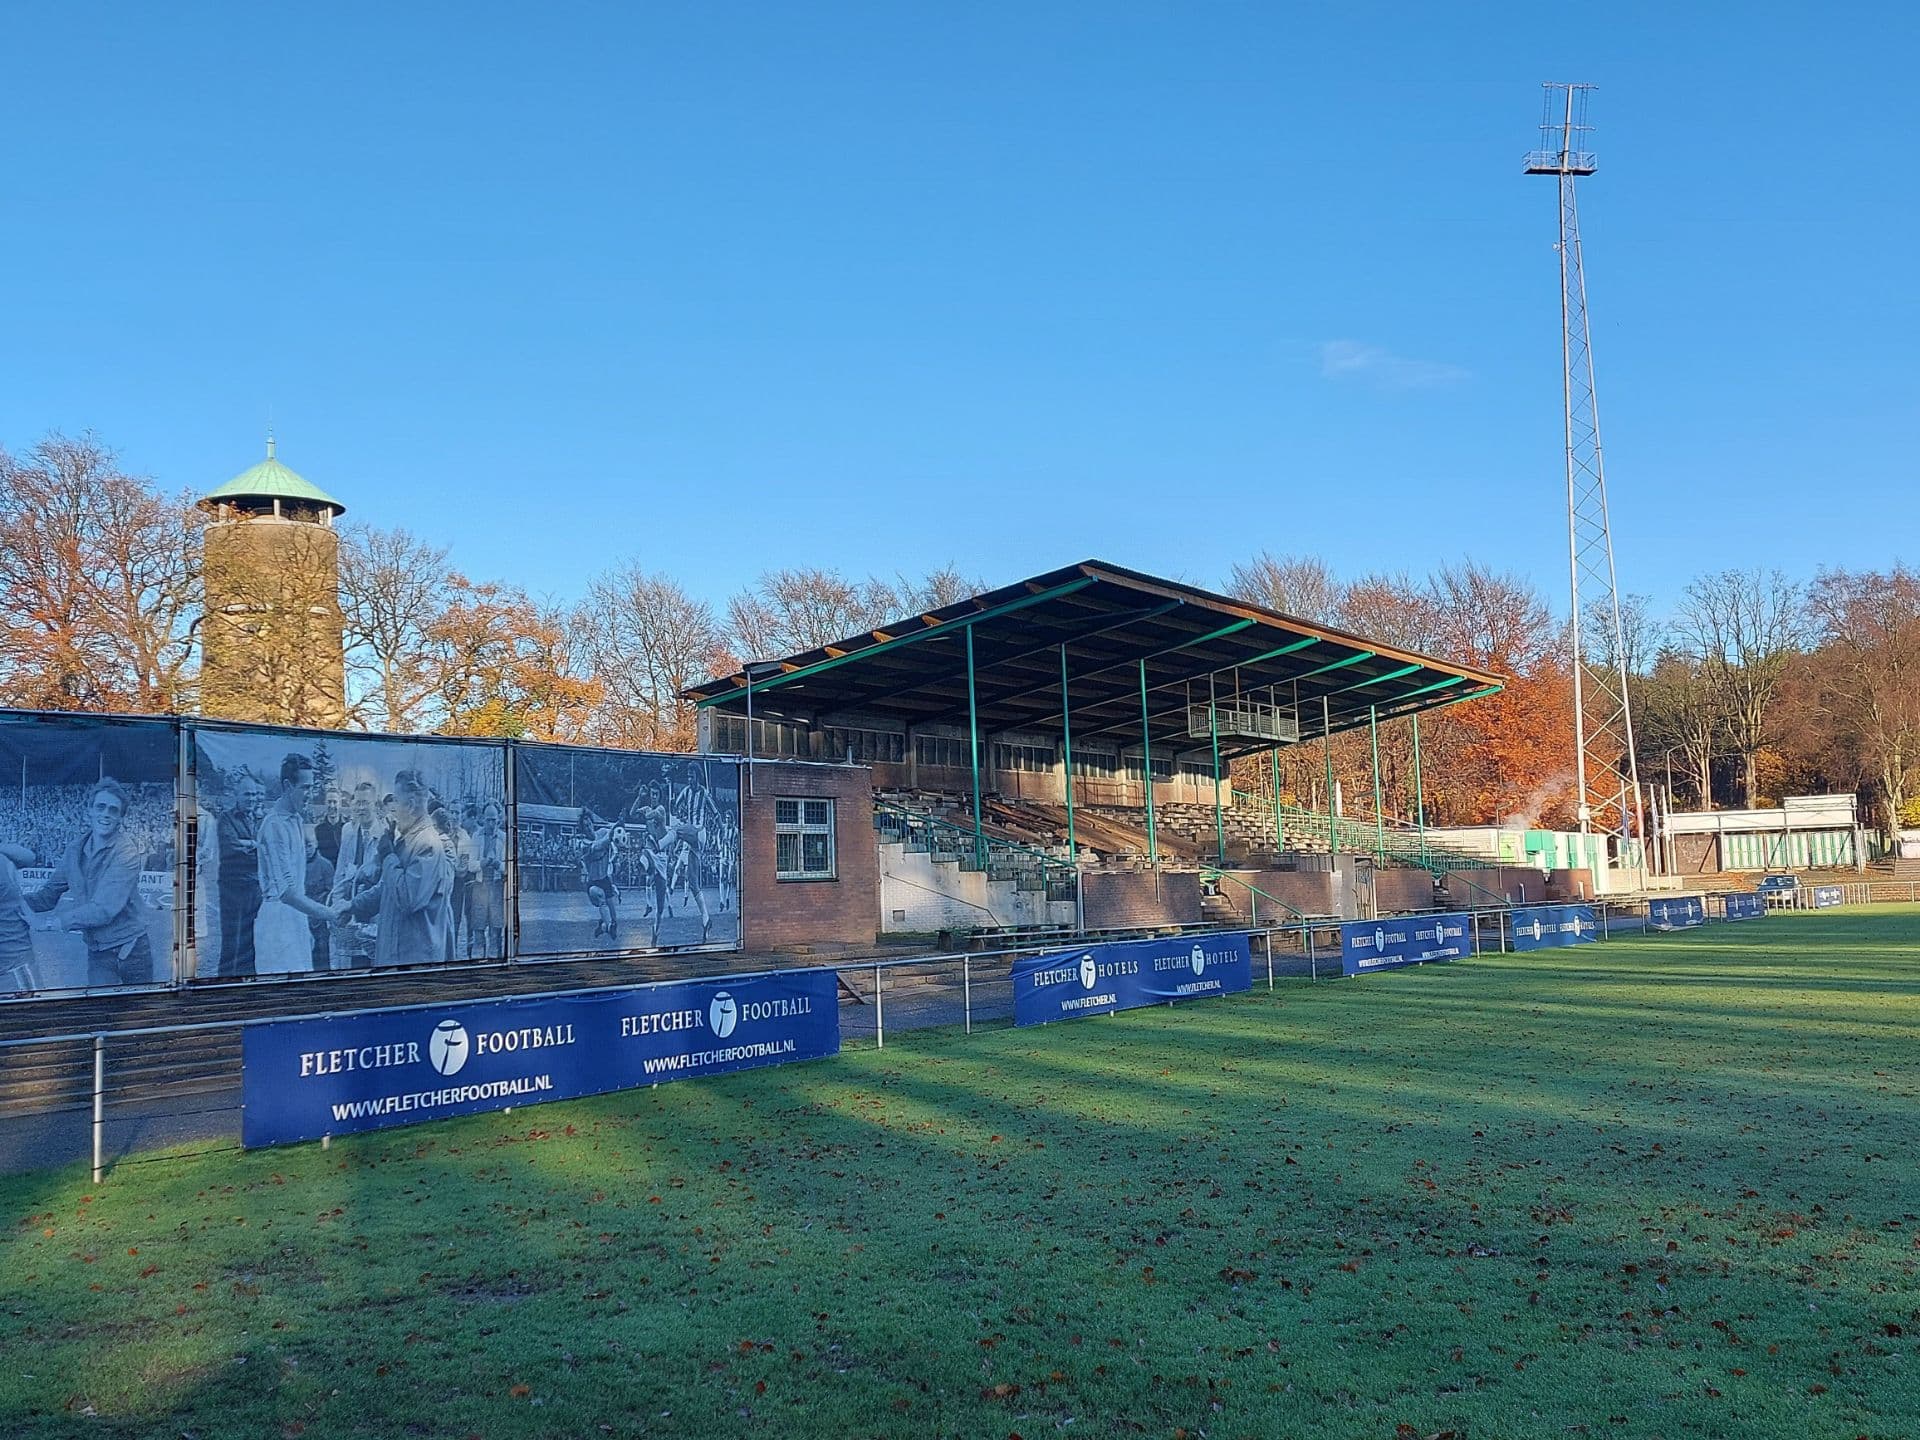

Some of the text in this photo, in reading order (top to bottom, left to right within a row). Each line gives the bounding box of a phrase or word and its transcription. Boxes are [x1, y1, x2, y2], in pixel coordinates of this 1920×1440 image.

[1034, 960, 1138, 987] FLETCHER HOTELS
[1154, 950, 1239, 971] FLETCHER HOTELS
[620, 996, 812, 1037] FLETCHER FOOTBALL
[299, 1024, 576, 1077] FLETCHER FOOTBALL
[644, 1039, 796, 1075] WWW.FLETCHERFOOTBALL.NL
[331, 1074, 554, 1122] WWW.FLETCHERFOOTBALL.NL
